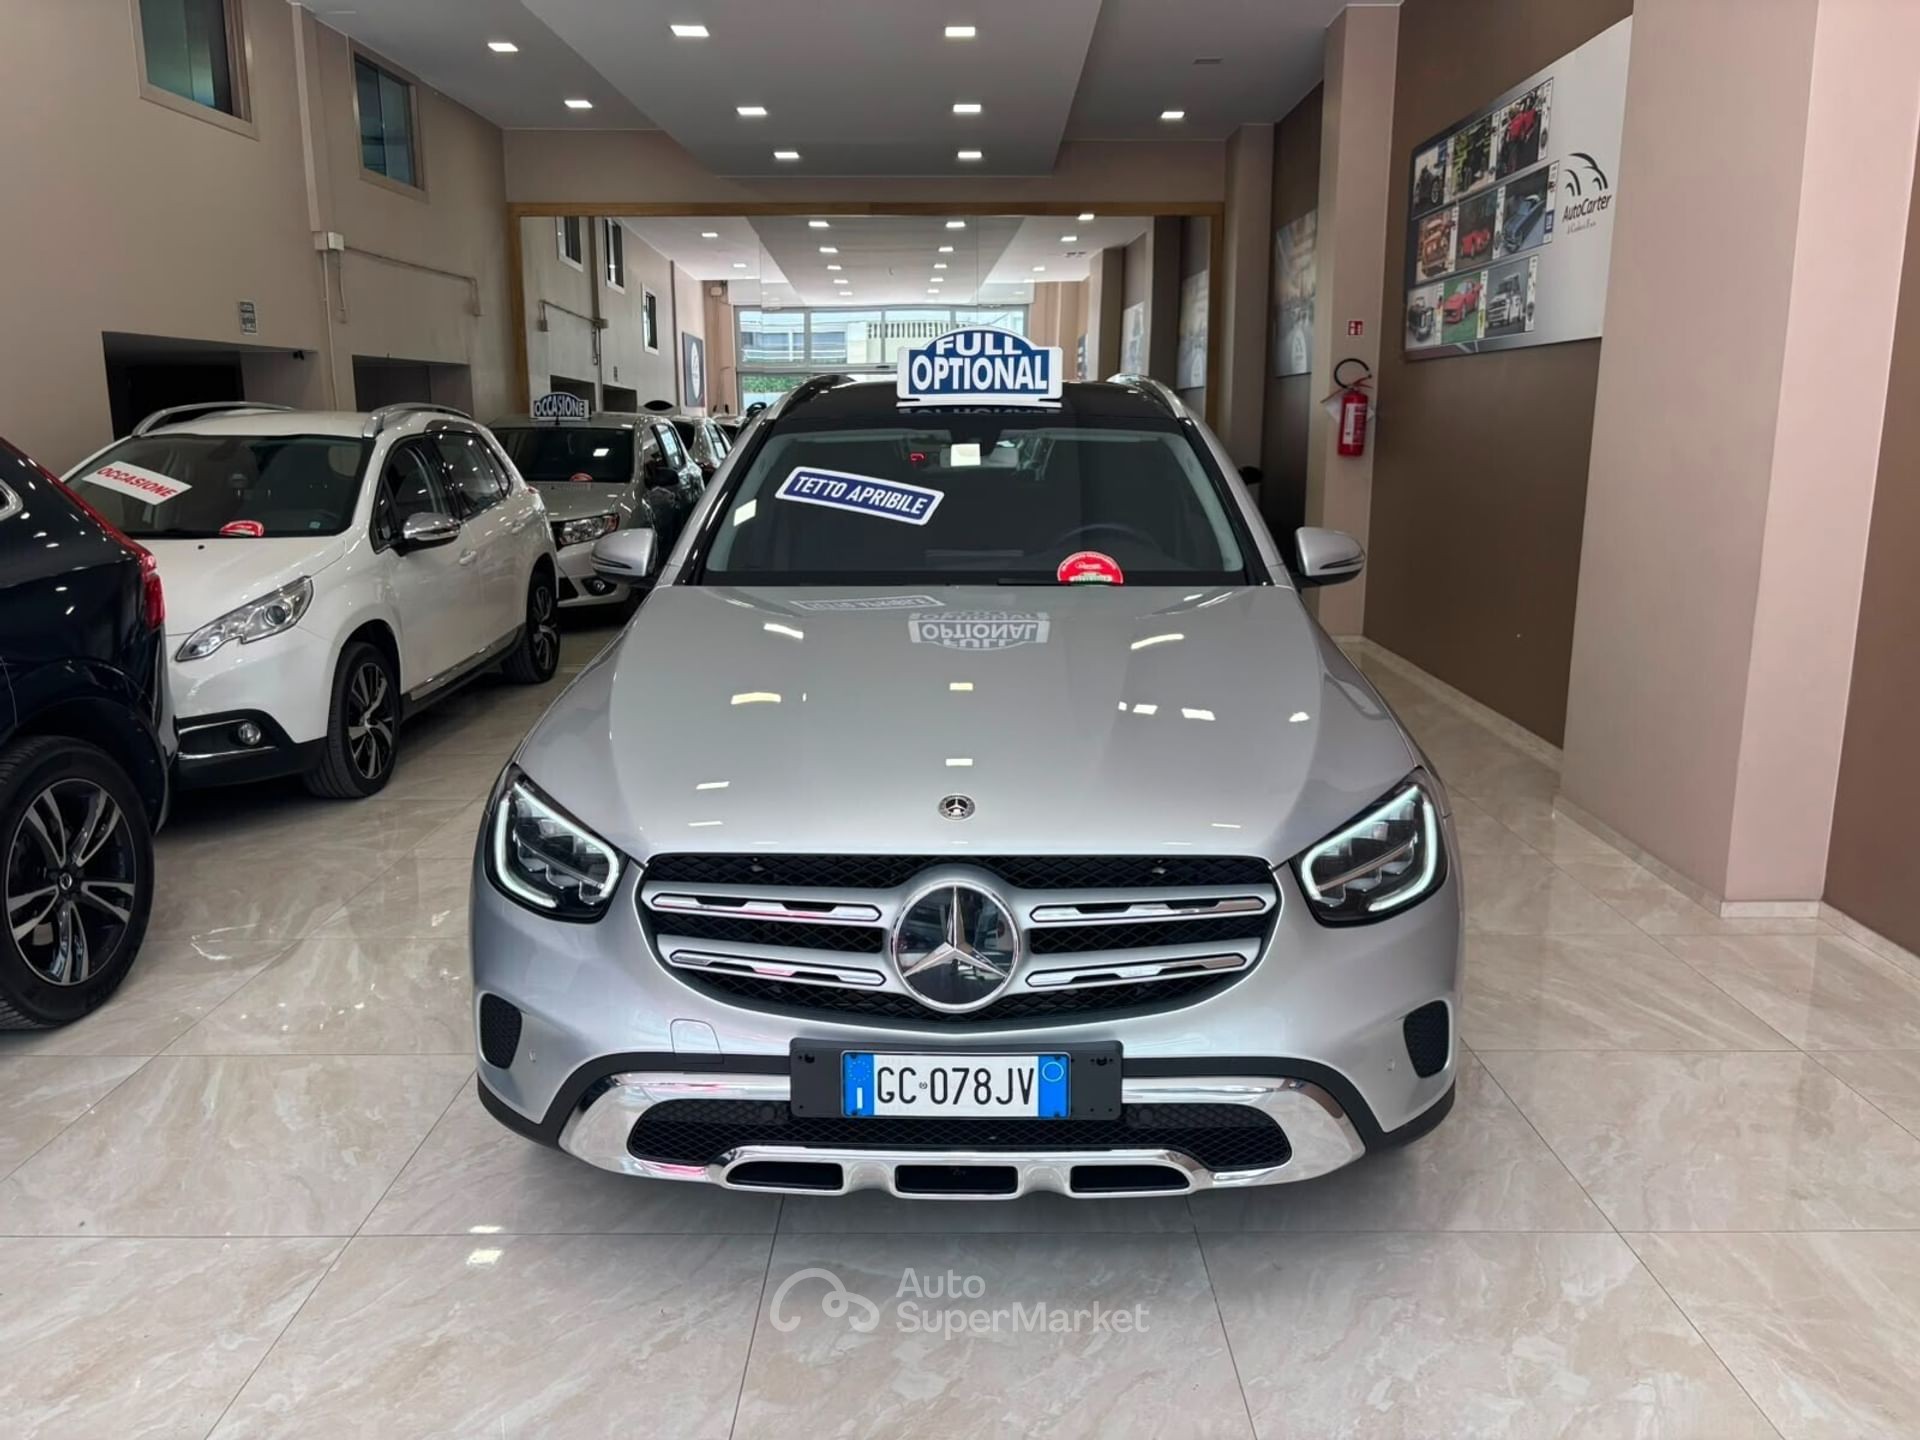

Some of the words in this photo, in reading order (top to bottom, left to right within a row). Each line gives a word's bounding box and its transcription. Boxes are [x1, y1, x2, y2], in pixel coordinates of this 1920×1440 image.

[1562, 195, 1612, 222] AutoCarter
[936, 332, 1022, 356] FULL
[911, 355, 1048, 391] OPTIONAL
[535, 395, 585, 416] OCCASIONE
[97, 467, 178, 498] OCCASIONE
[793, 476, 848, 498] TETTO
[845, 485, 929, 515] APRIBILE
